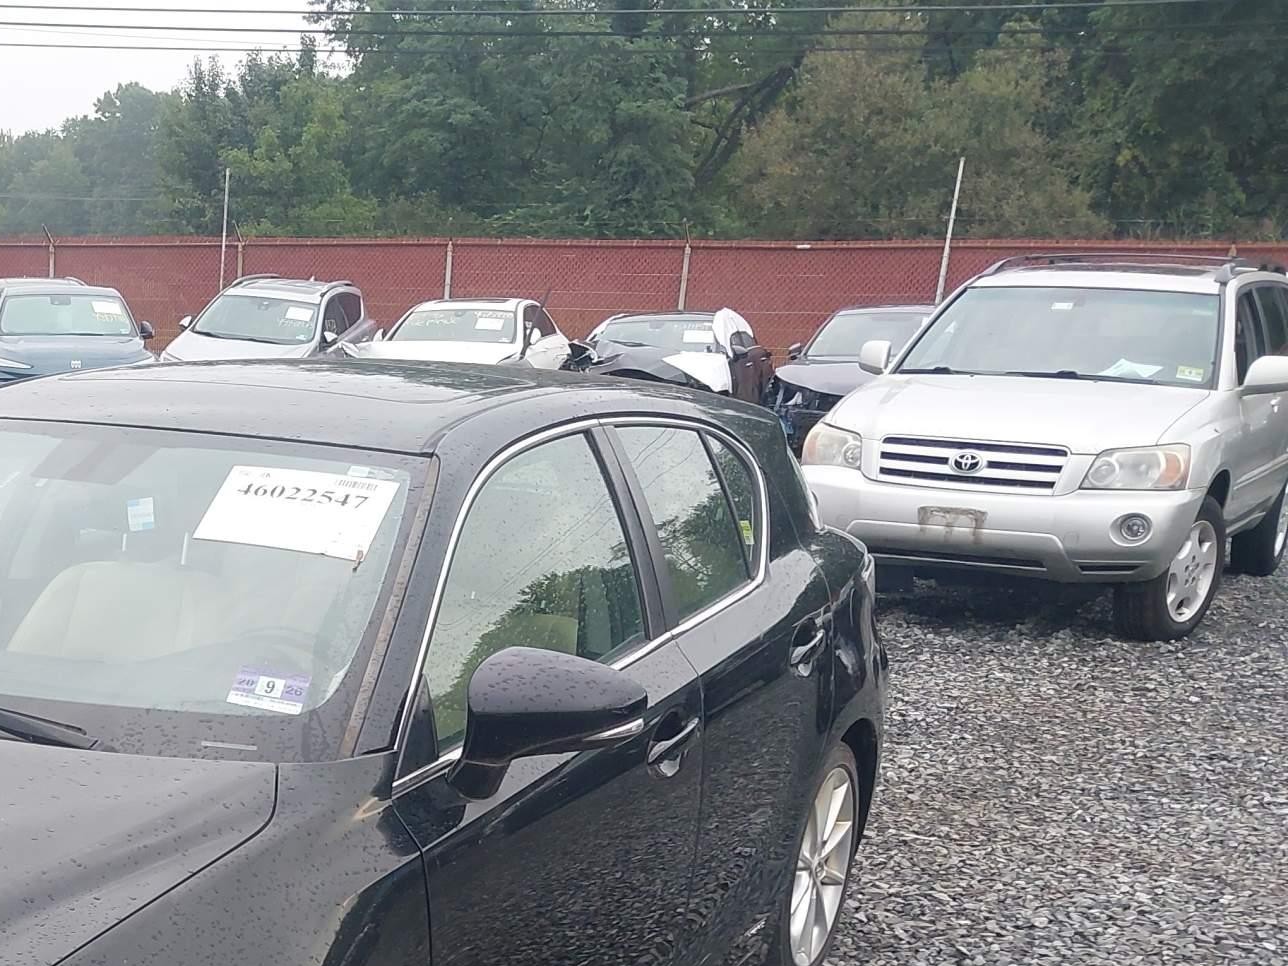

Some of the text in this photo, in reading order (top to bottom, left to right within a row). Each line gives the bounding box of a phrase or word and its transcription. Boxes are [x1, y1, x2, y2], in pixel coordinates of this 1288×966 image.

[237, 483, 369, 509] 46022547
[238, 678, 304, 697] 20 9 26
